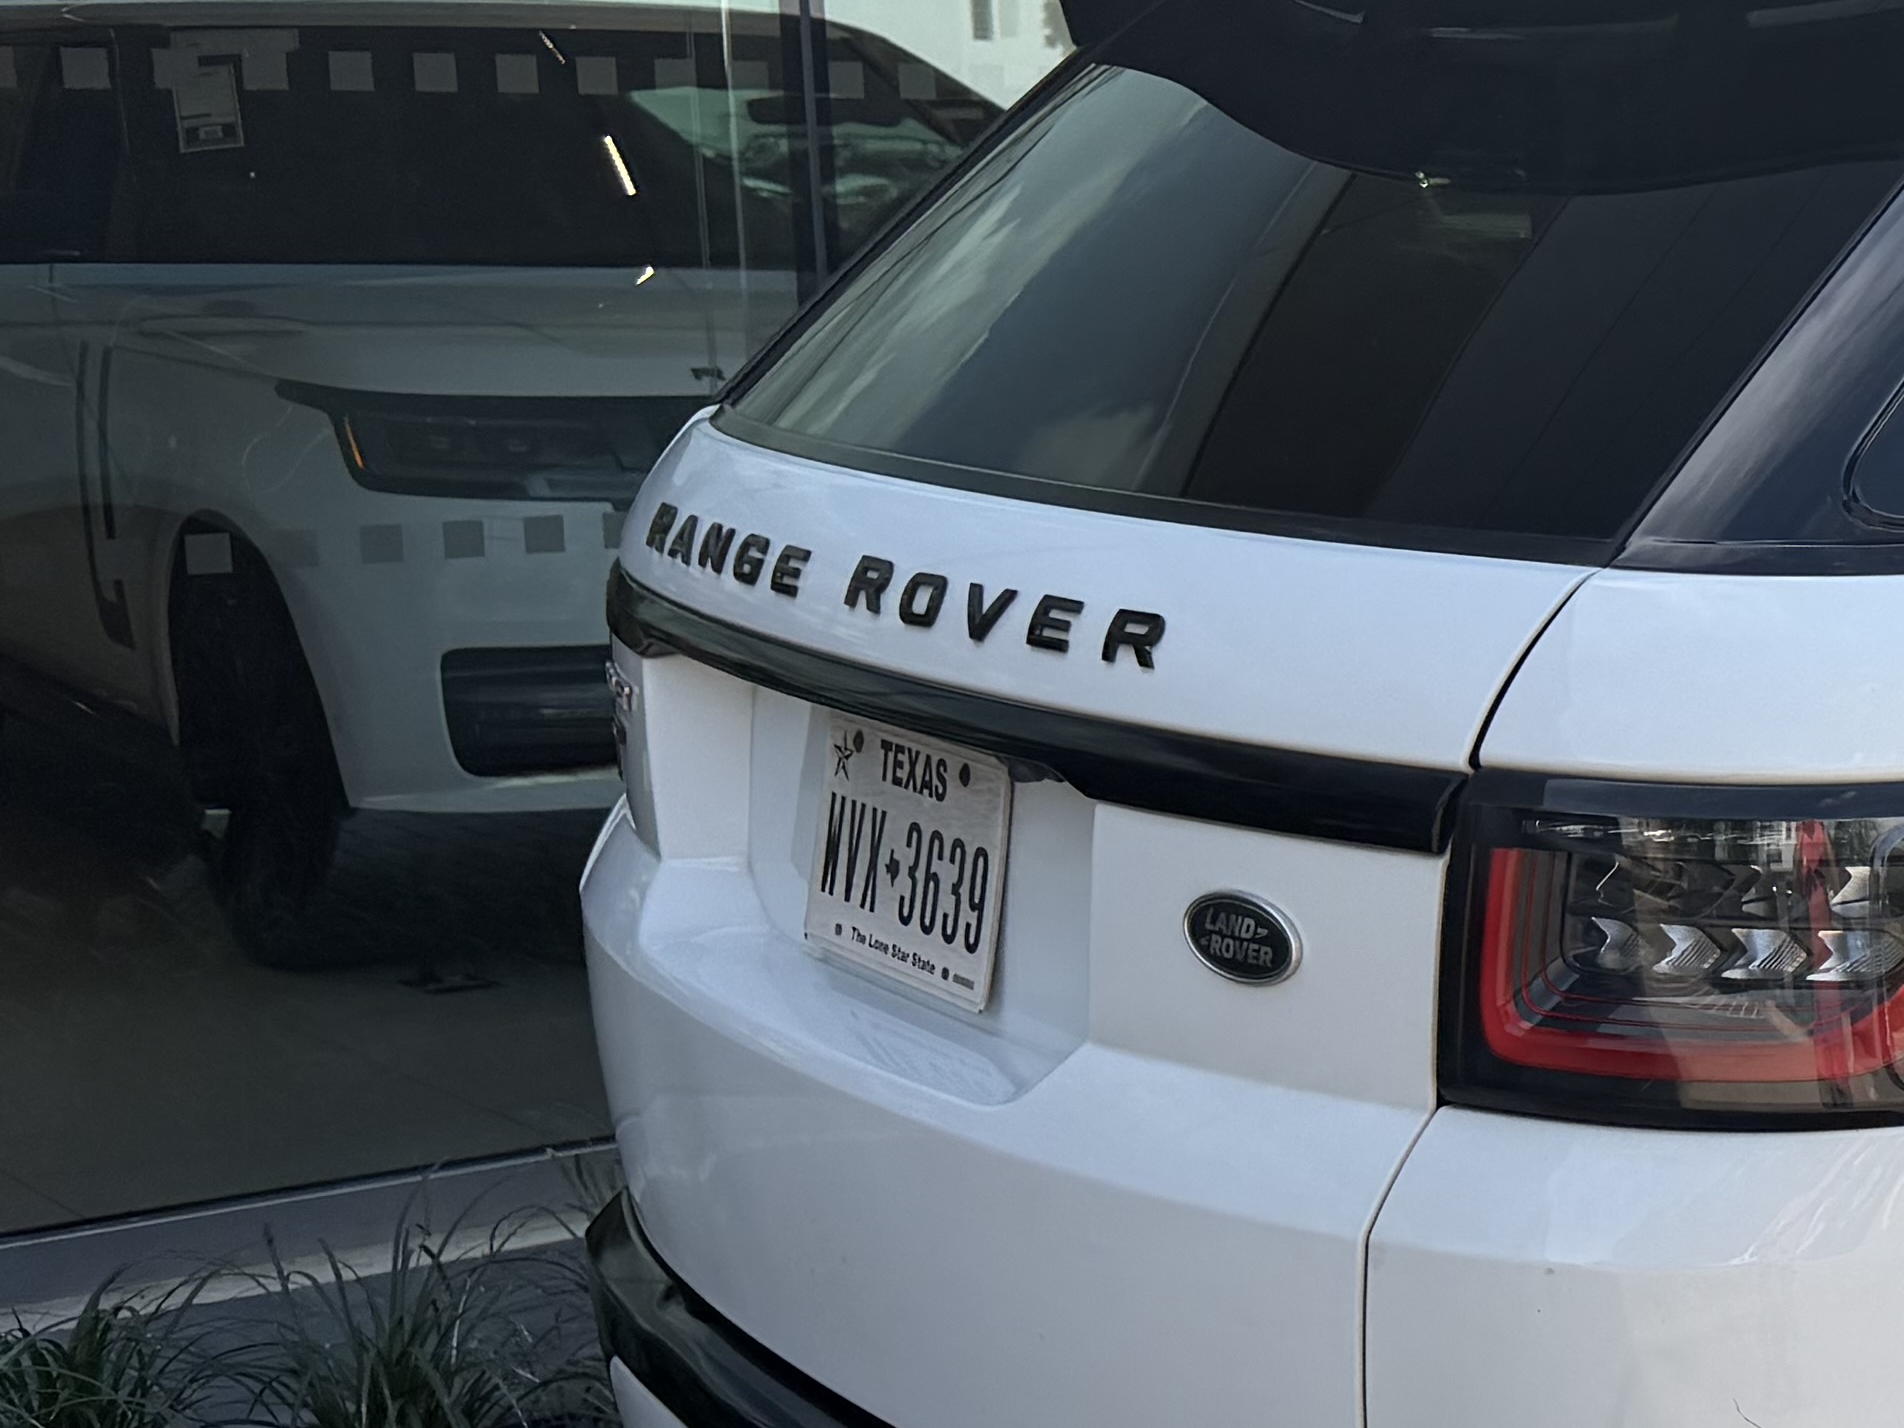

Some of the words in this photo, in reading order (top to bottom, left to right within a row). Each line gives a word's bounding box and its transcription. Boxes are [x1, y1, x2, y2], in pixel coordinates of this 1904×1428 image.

[645, 502, 812, 598] RANGE
[843, 554, 1166, 670] ROVER
[880, 738, 948, 802] TEXAS
[897, 821, 989, 955] 3639
[851, 925, 866, 946] The
[868, 933, 890, 956] Lone
[891, 943, 910, 964] Star
[911, 952, 936, 976] State
[1203, 907, 1256, 940] LAND
[1209, 933, 1274, 968] ROVER
